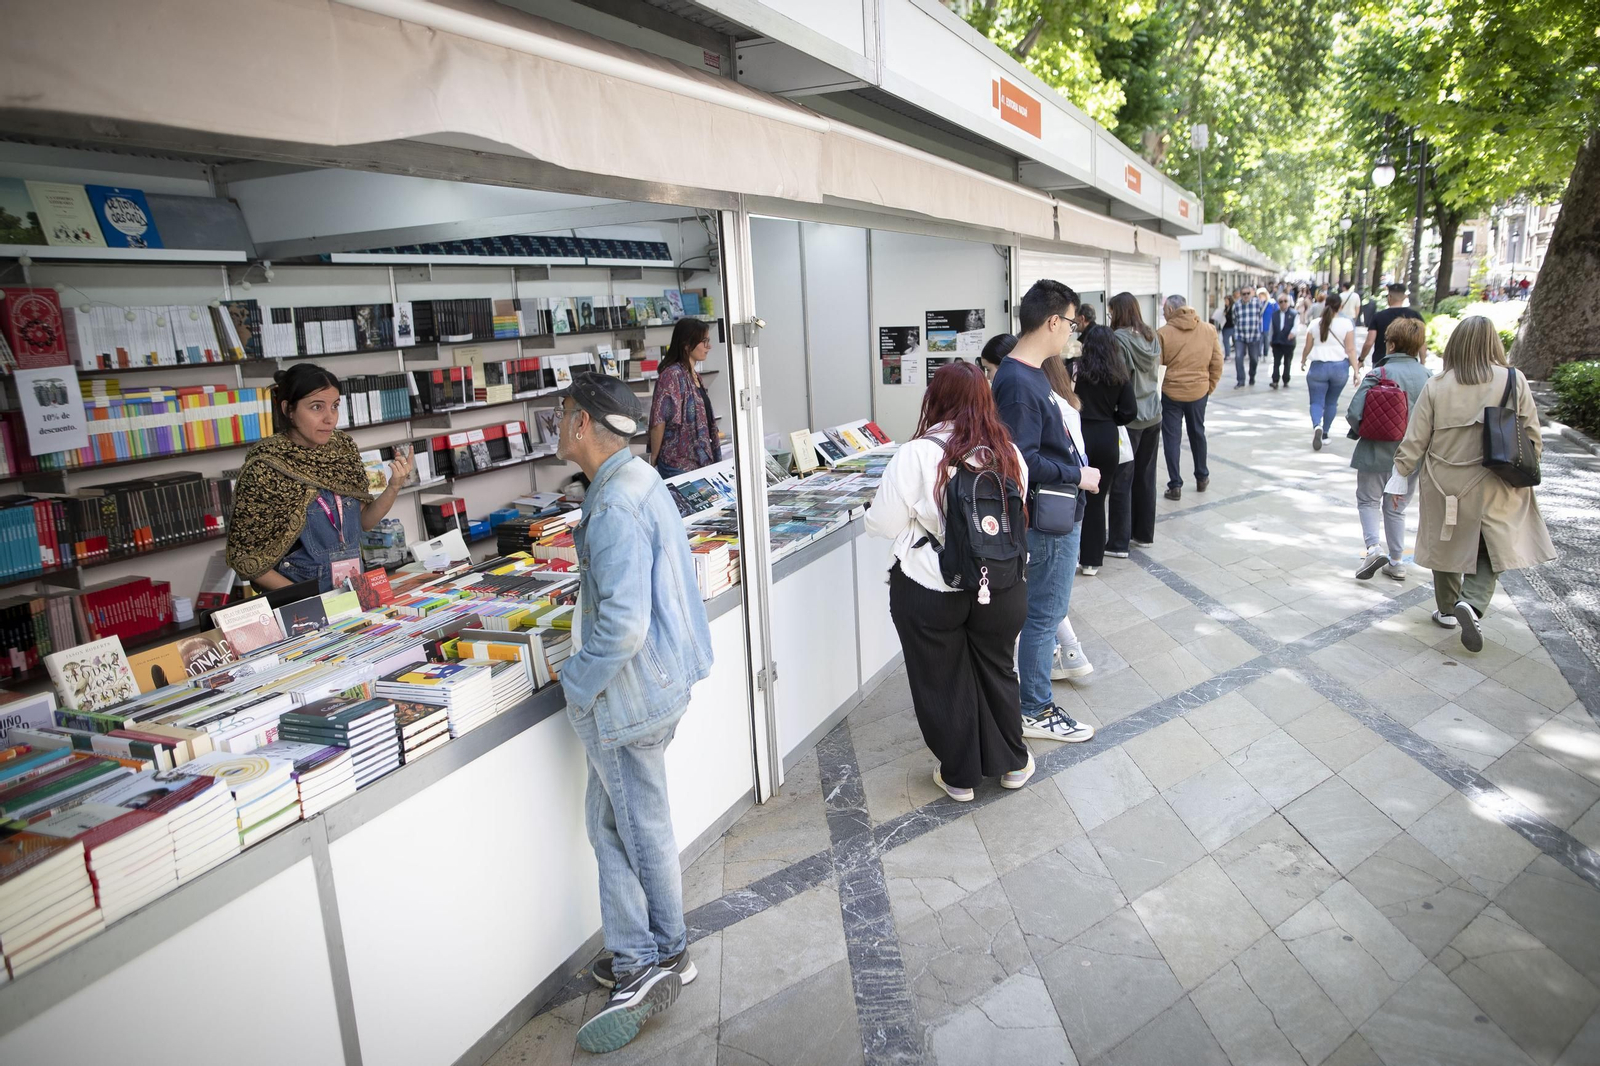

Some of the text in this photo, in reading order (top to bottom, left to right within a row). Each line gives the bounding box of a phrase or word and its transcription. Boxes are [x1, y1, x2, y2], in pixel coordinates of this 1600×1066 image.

[42, 413, 60, 422] 10%
[39, 425, 77, 435] descuento.
[65, 641, 111, 660] JASON ROBERTS
